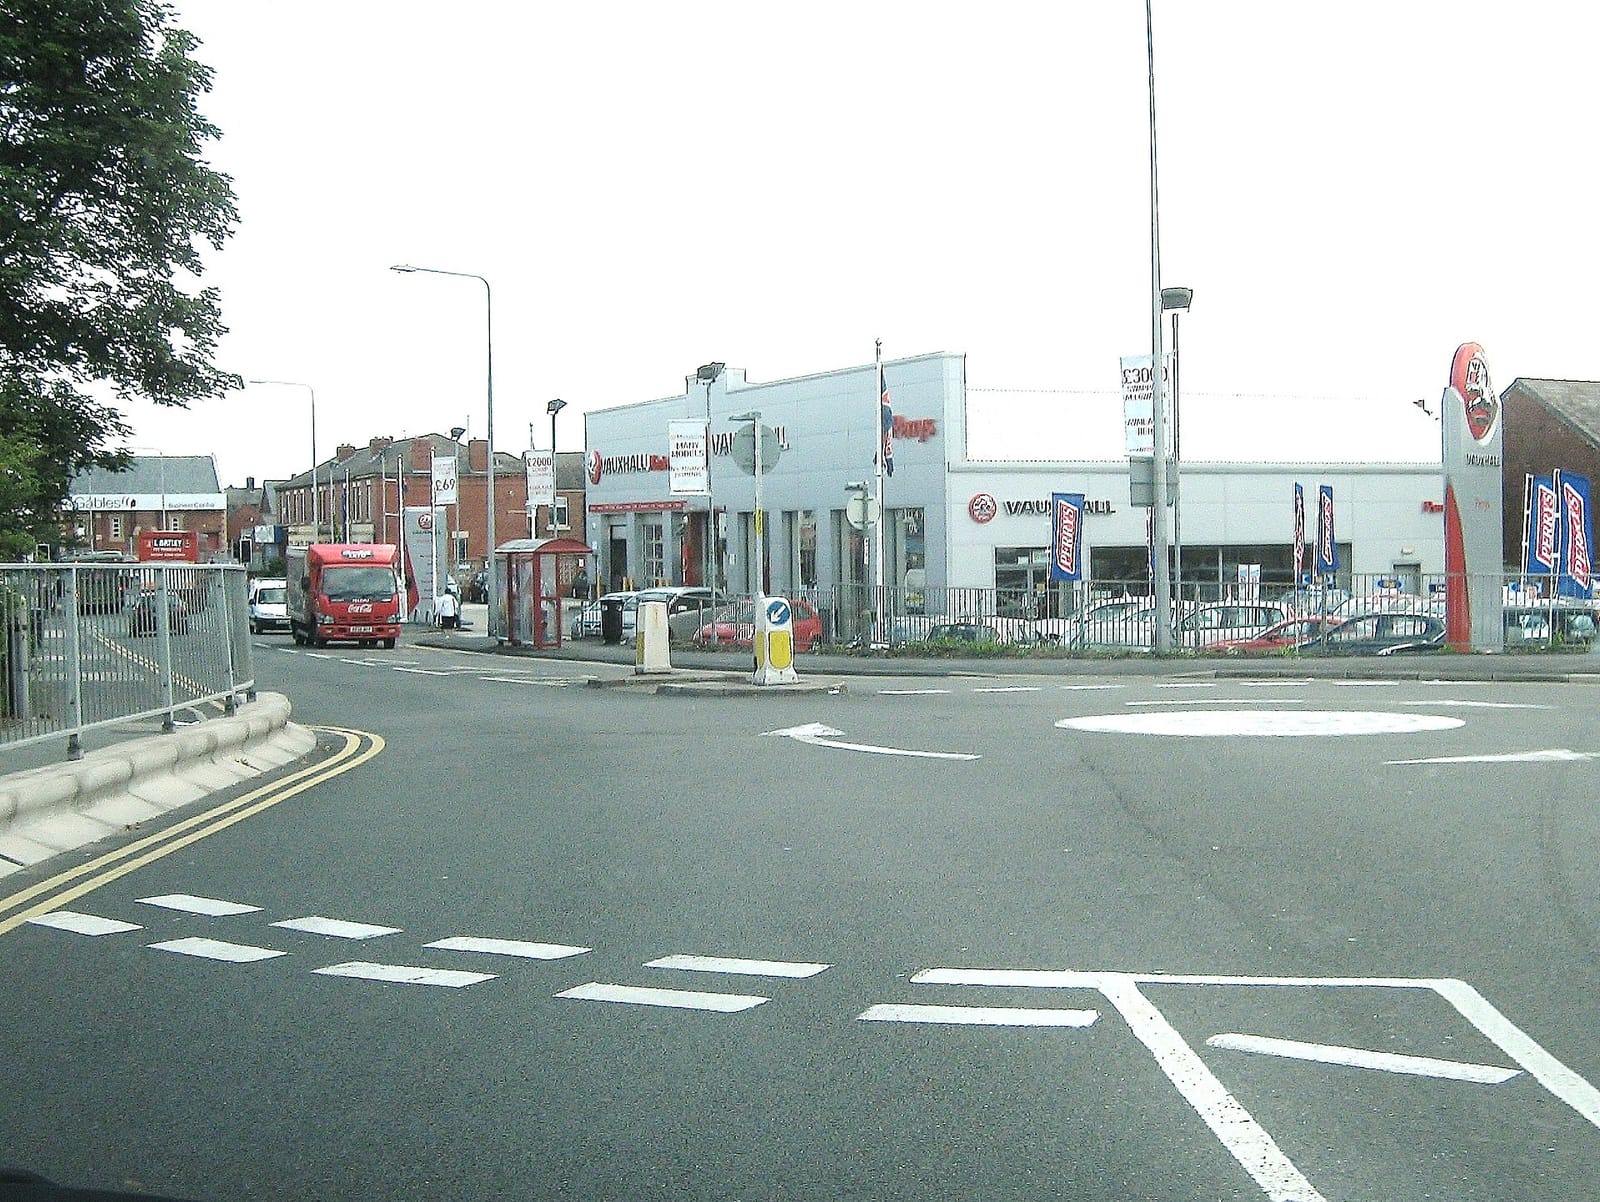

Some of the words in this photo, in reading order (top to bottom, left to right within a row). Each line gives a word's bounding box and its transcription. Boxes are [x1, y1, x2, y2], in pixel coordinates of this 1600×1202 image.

[1123, 367, 1168, 384] £30
[675, 442, 699, 450] MANY
[671, 450, 705, 458] MODELS
[1466, 453, 1500, 467] VAUXHALL
[527, 457, 552, 467] £2000
[601, 453, 648, 475] VAUXHALL
[435, 478, 456, 492] £69
[1004, 500, 1116, 516] VAUALL
[1540, 489, 1555, 565] PERRYS
[1058, 504, 1077, 572] PERRYS
